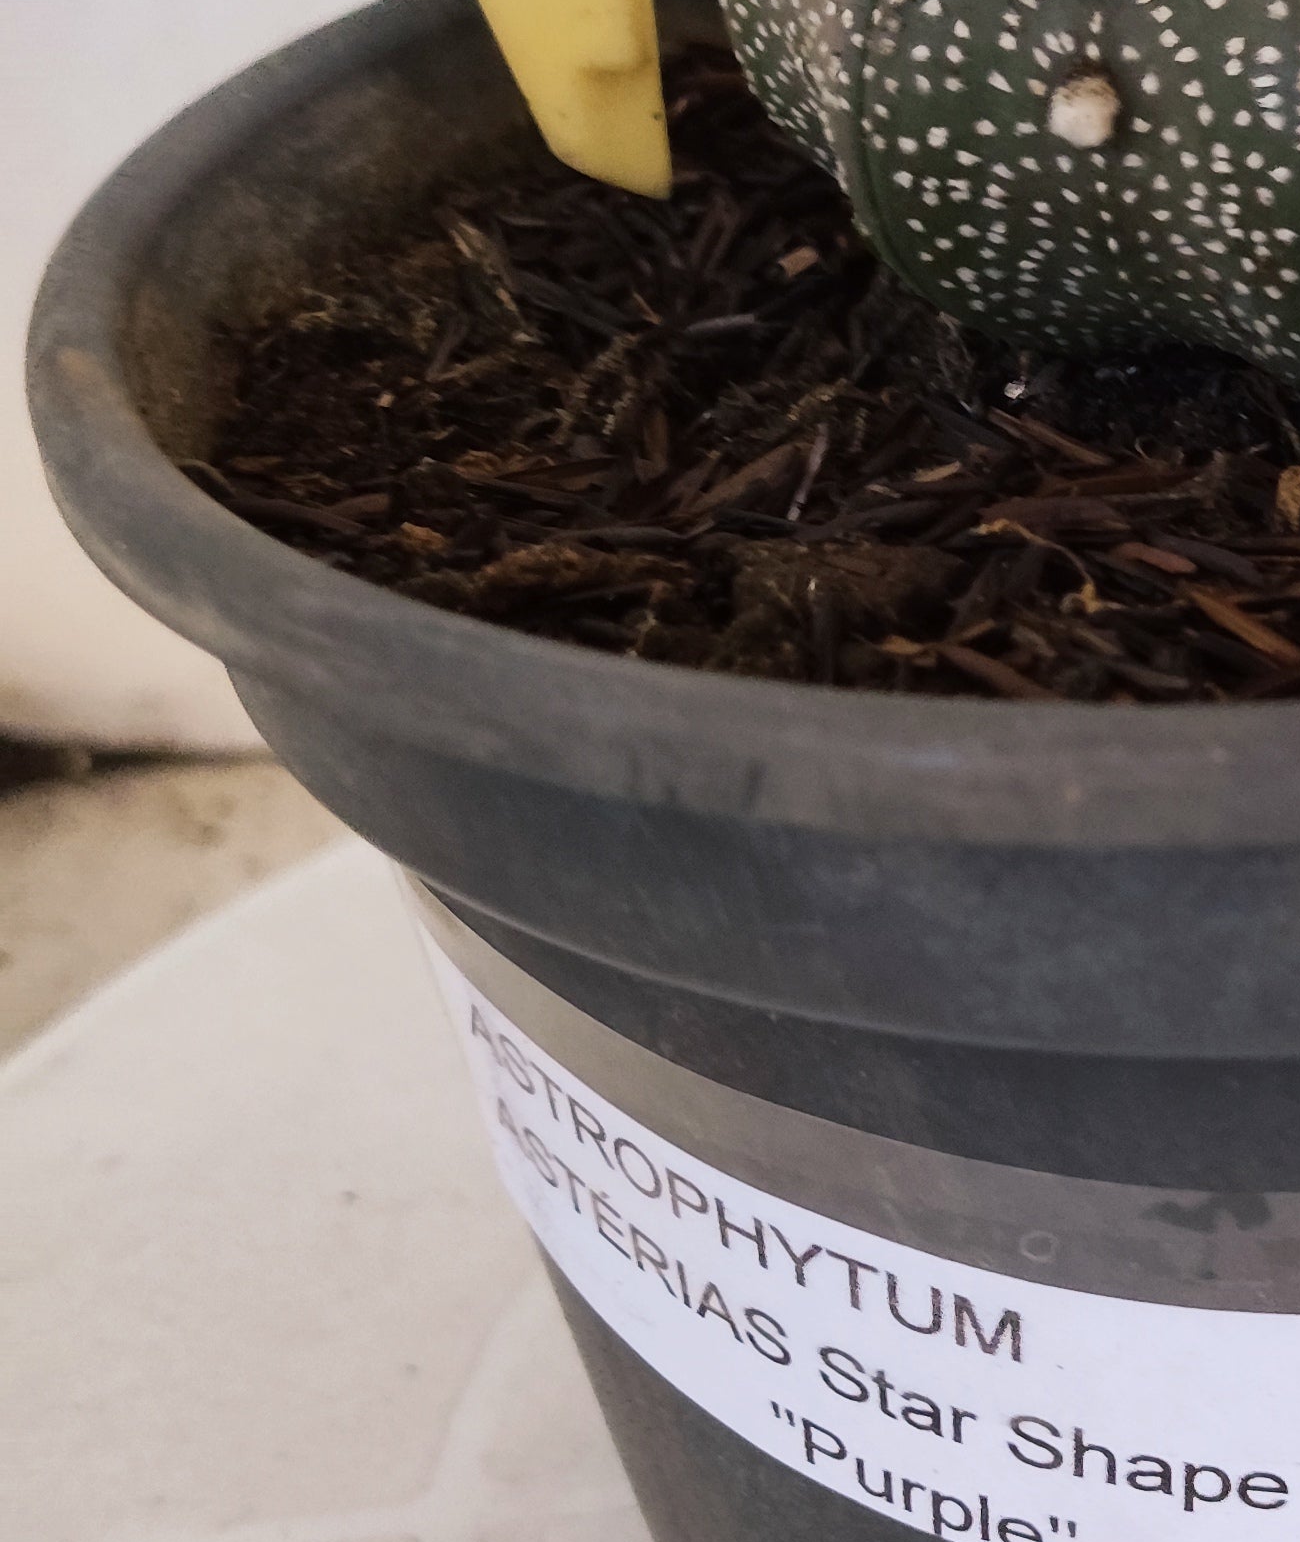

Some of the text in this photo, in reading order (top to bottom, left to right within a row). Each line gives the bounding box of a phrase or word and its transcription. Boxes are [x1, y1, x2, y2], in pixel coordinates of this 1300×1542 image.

[470, 1003, 1024, 1363] ASTROPHYTUM
[497, 1094, 1291, 1513] ASTÉRIAS Star Shape
